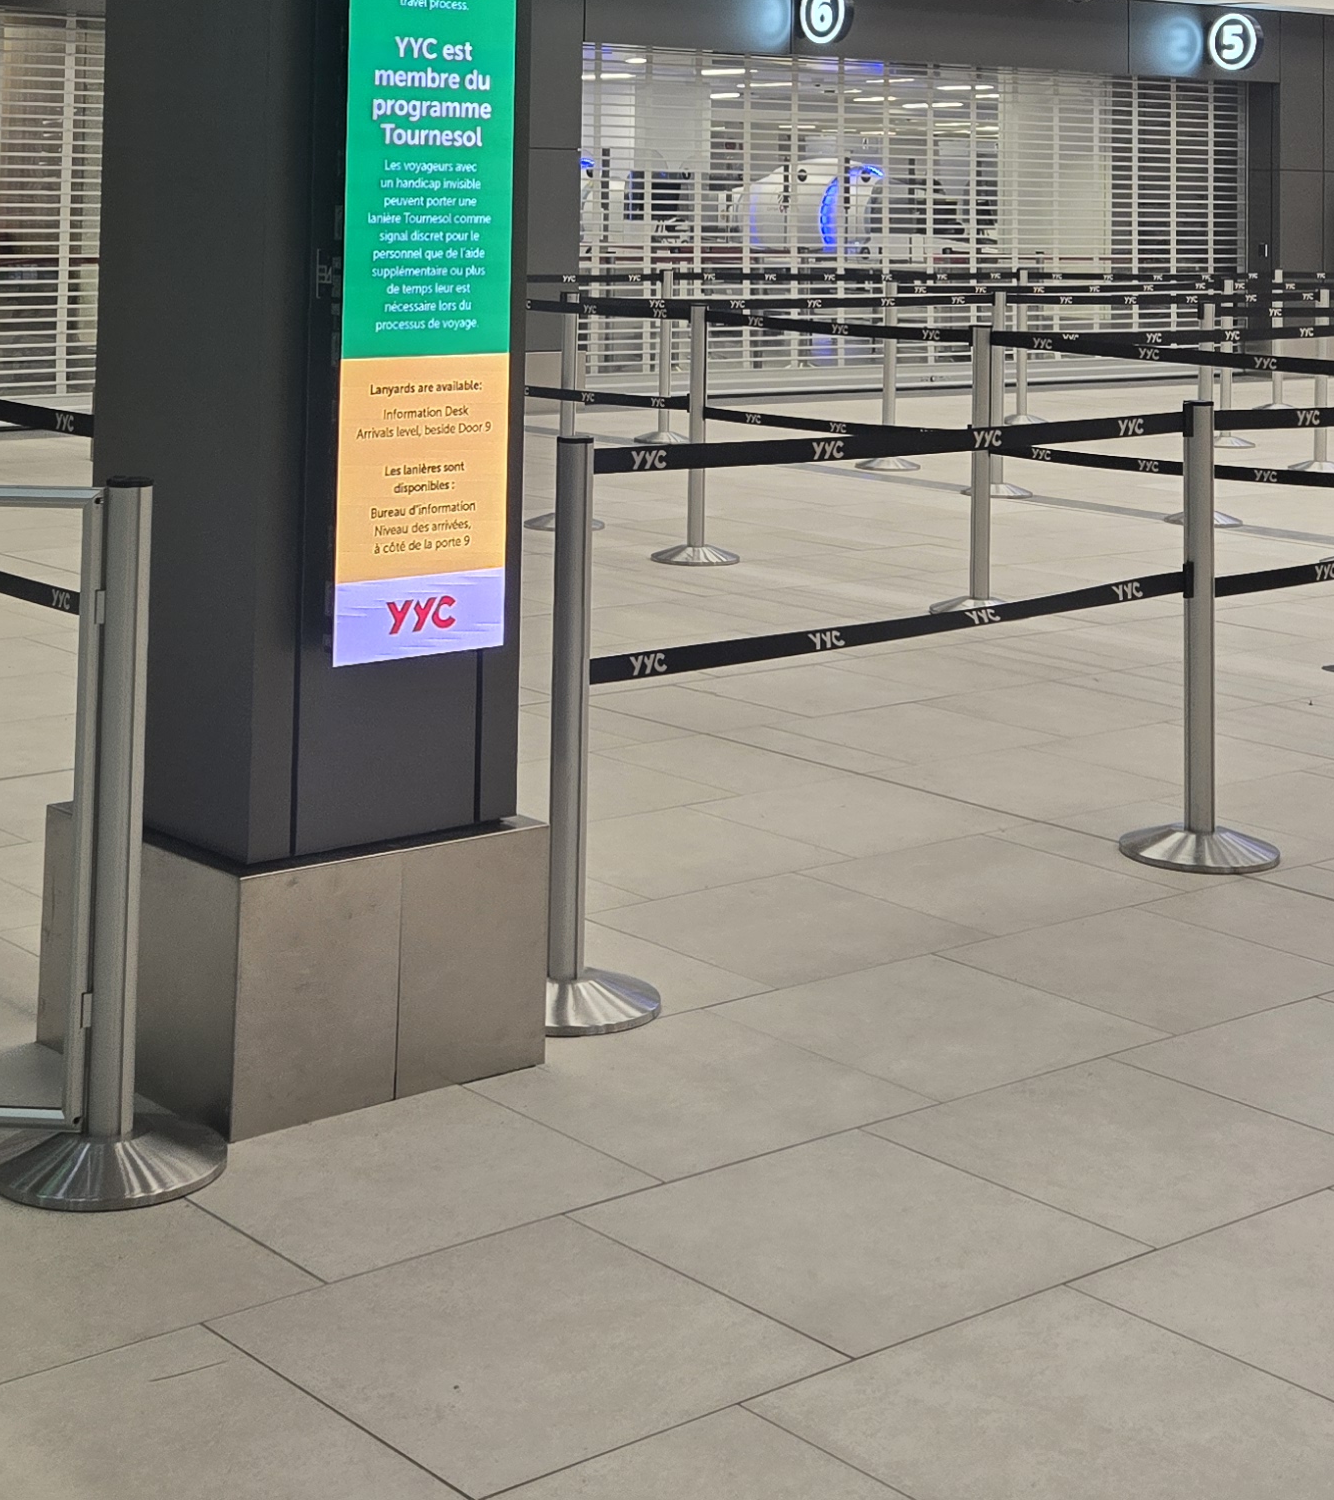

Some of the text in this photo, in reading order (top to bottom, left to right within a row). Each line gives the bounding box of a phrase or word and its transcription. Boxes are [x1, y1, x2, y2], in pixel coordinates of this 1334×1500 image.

[430, 1, 468, 10] process.
[395, 36, 472, 61] YYC est
[1223, 25, 1243, 59] 5
[375, 67, 490, 90] membre du
[373, 99, 491, 121] programme
[380, 124, 482, 146] Tournesol
[385, 160, 477, 173] Les voyageurs avec
[381, 178, 481, 190] un handicap invisible
[384, 197, 477, 208] peuvent porter une
[368, 212, 491, 223] lanière Tournesol comme
[379, 231, 479, 243] signal discret pour le
[373, 249, 422, 261] personnel
[425, 250, 443, 262] que
[446, 249, 457, 258] de
[372, 266, 447, 278] supplémentaire
[465, 265, 485, 277] plus
[387, 284, 470, 295] de temps leur est
[385, 300, 471, 312] nécessaire lors du
[376, 320, 425, 332] processus
[428, 319, 439, 328] de
[1224, 330, 1241, 341] YYC
[922, 329, 1160, 360] YYC YYC YYC
[1253, 356, 1277, 370] YYC
[370, 383, 415, 396] Lanyards
[436, 381, 482, 392] available:
[384, 406, 469, 419] Information Desk
[356, 422, 491, 439] Arrivals level, beside Door 9
[631, 449, 667, 470] YYC
[812, 440, 844, 460] YYC
[973, 429, 1002, 449] YYC
[1117, 418, 1144, 436] YYC
[1296, 409, 1320, 426] YYC
[385, 462, 464, 476] Les lanières sont
[1137, 459, 1159, 472] YYC
[1254, 469, 1277, 483] YYC
[394, 482, 449, 495] disponibles
[371, 507, 405, 518] Bureau
[375, 519, 472, 536] Niveau des arrivées,
[374, 536, 470, 554] à côté de la porte 9
[386, 595, 456, 635] YYC
[629, 652, 668, 676] YYC
[807, 630, 846, 650] YYC
[964, 608, 1001, 625] YYC
[1111, 581, 1144, 601] YYC
